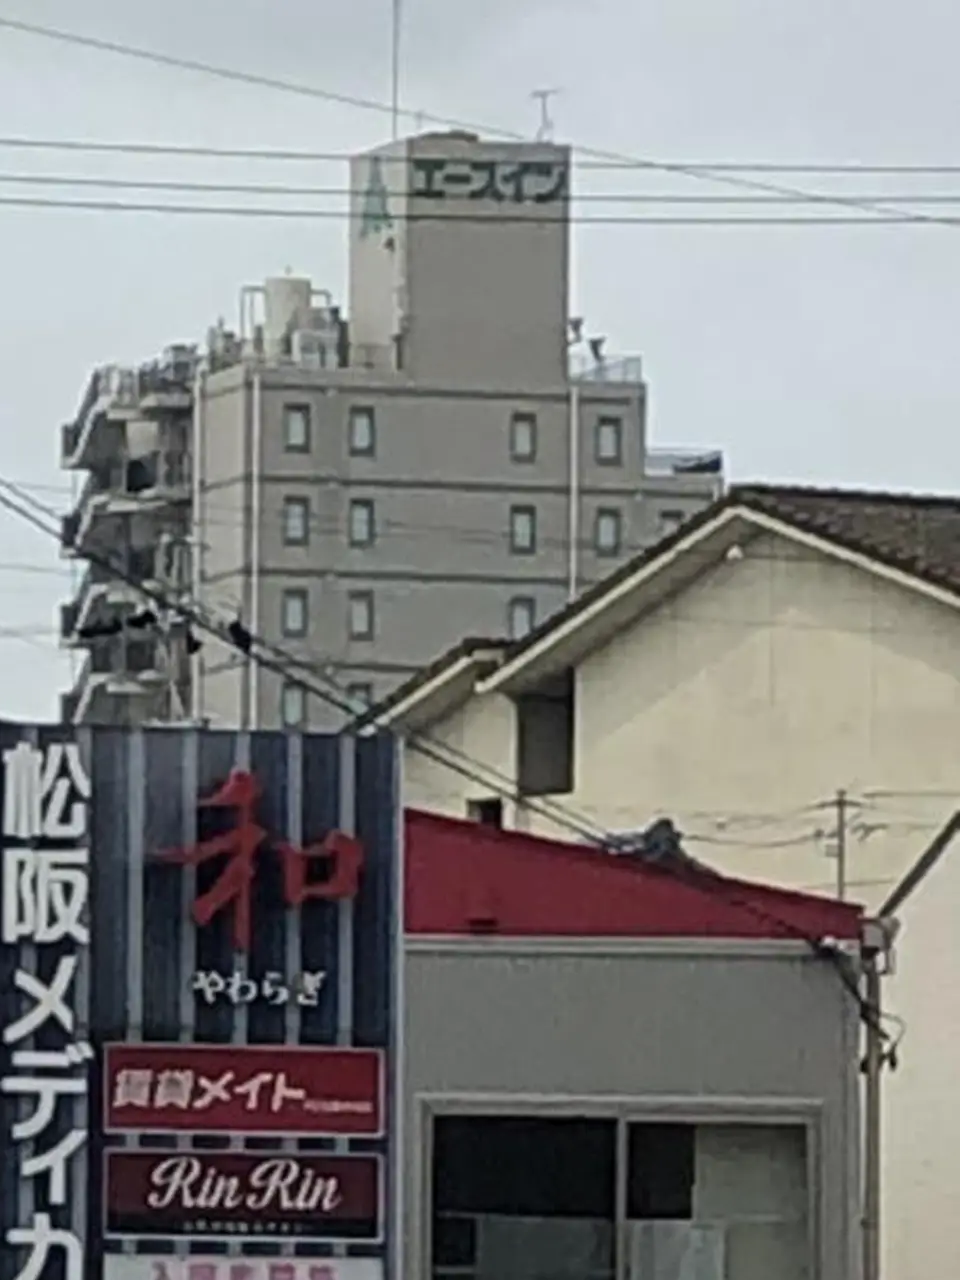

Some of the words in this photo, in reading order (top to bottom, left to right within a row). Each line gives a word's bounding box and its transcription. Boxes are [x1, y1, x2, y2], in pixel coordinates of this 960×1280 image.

[411, 158, 568, 203] エースイン
[144, 768, 365, 953] 和
[192, 970, 326, 1006] やわらぎ
[147, 1156, 240, 1210] Rin
[245, 1158, 343, 1212] Rin
